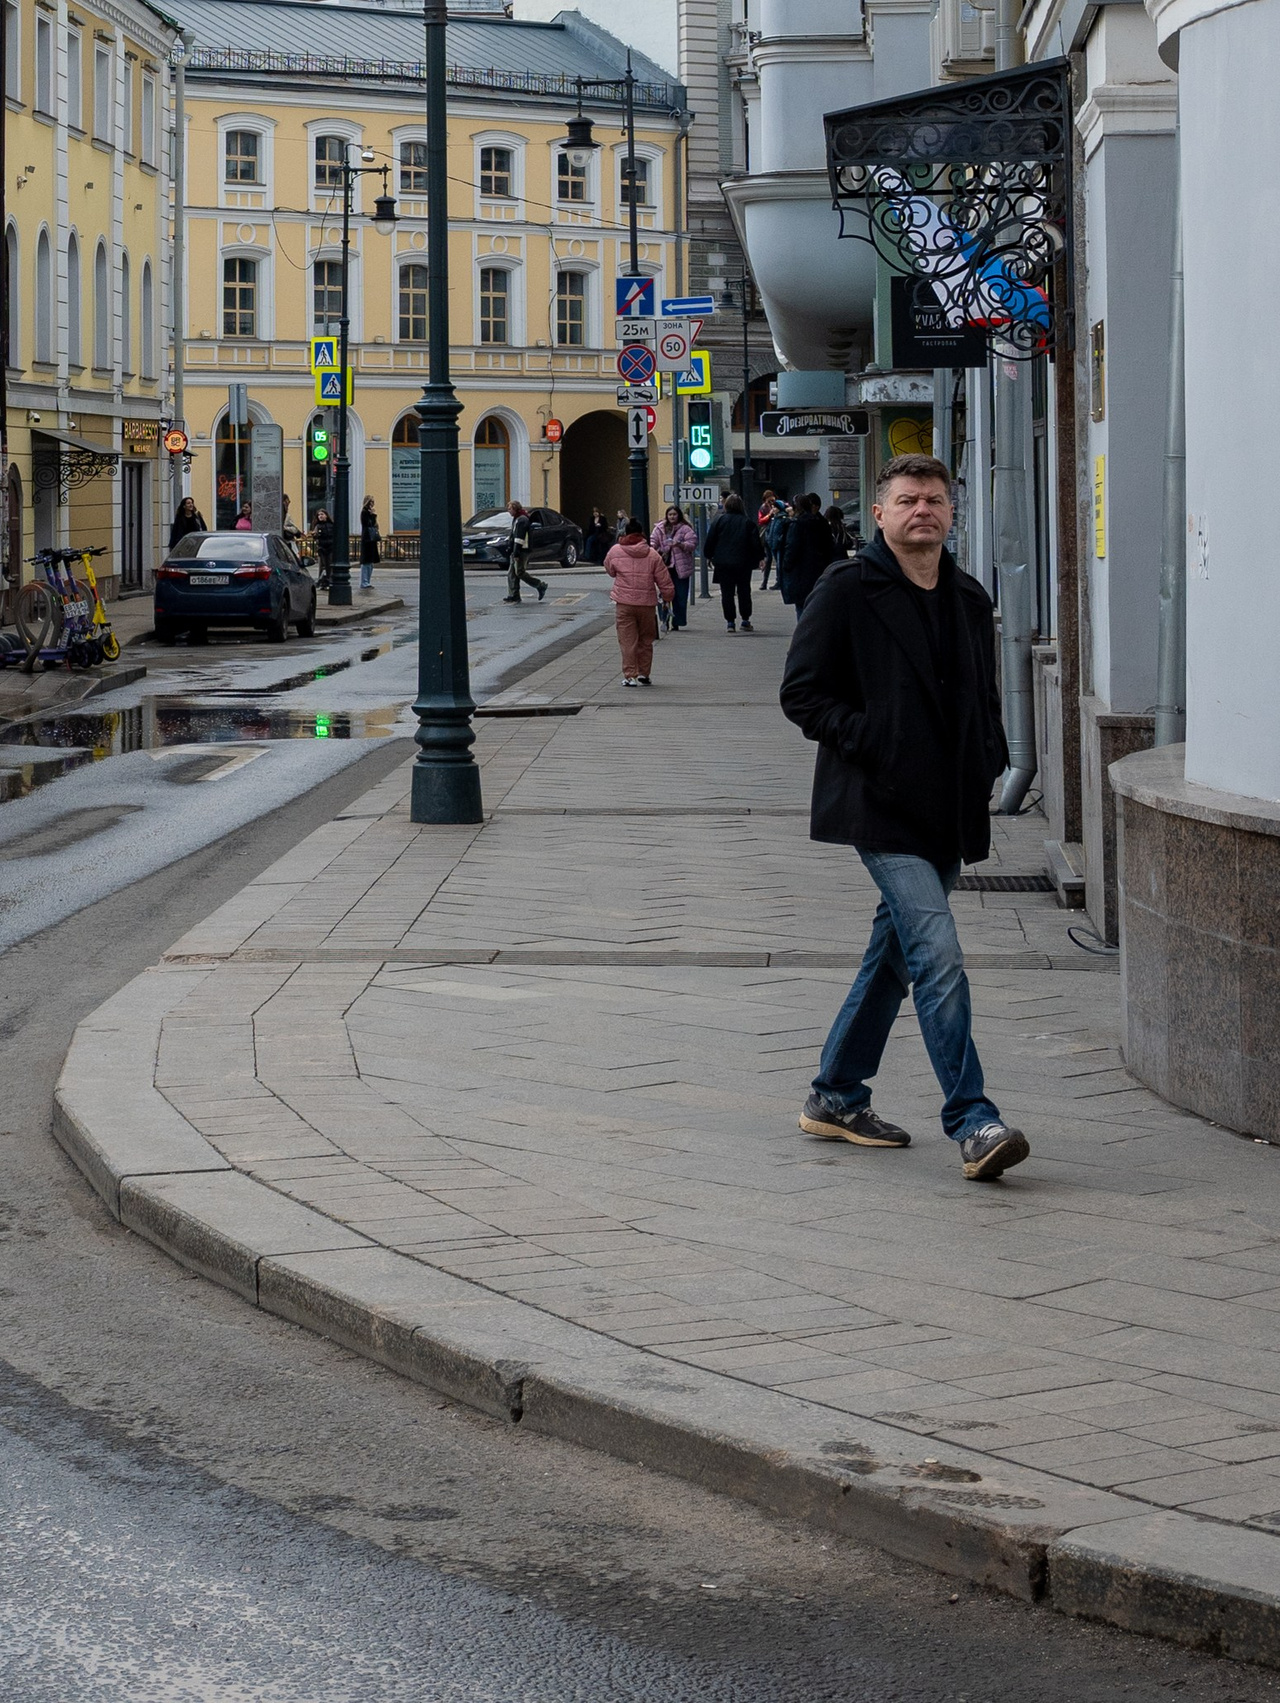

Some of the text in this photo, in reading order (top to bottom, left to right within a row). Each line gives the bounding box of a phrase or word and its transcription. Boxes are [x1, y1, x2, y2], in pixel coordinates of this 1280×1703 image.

[623, 324, 648, 336] 25м
[666, 342, 680, 352] 50
[314, 431, 326, 441] 05
[692, 426, 710, 446] 05
